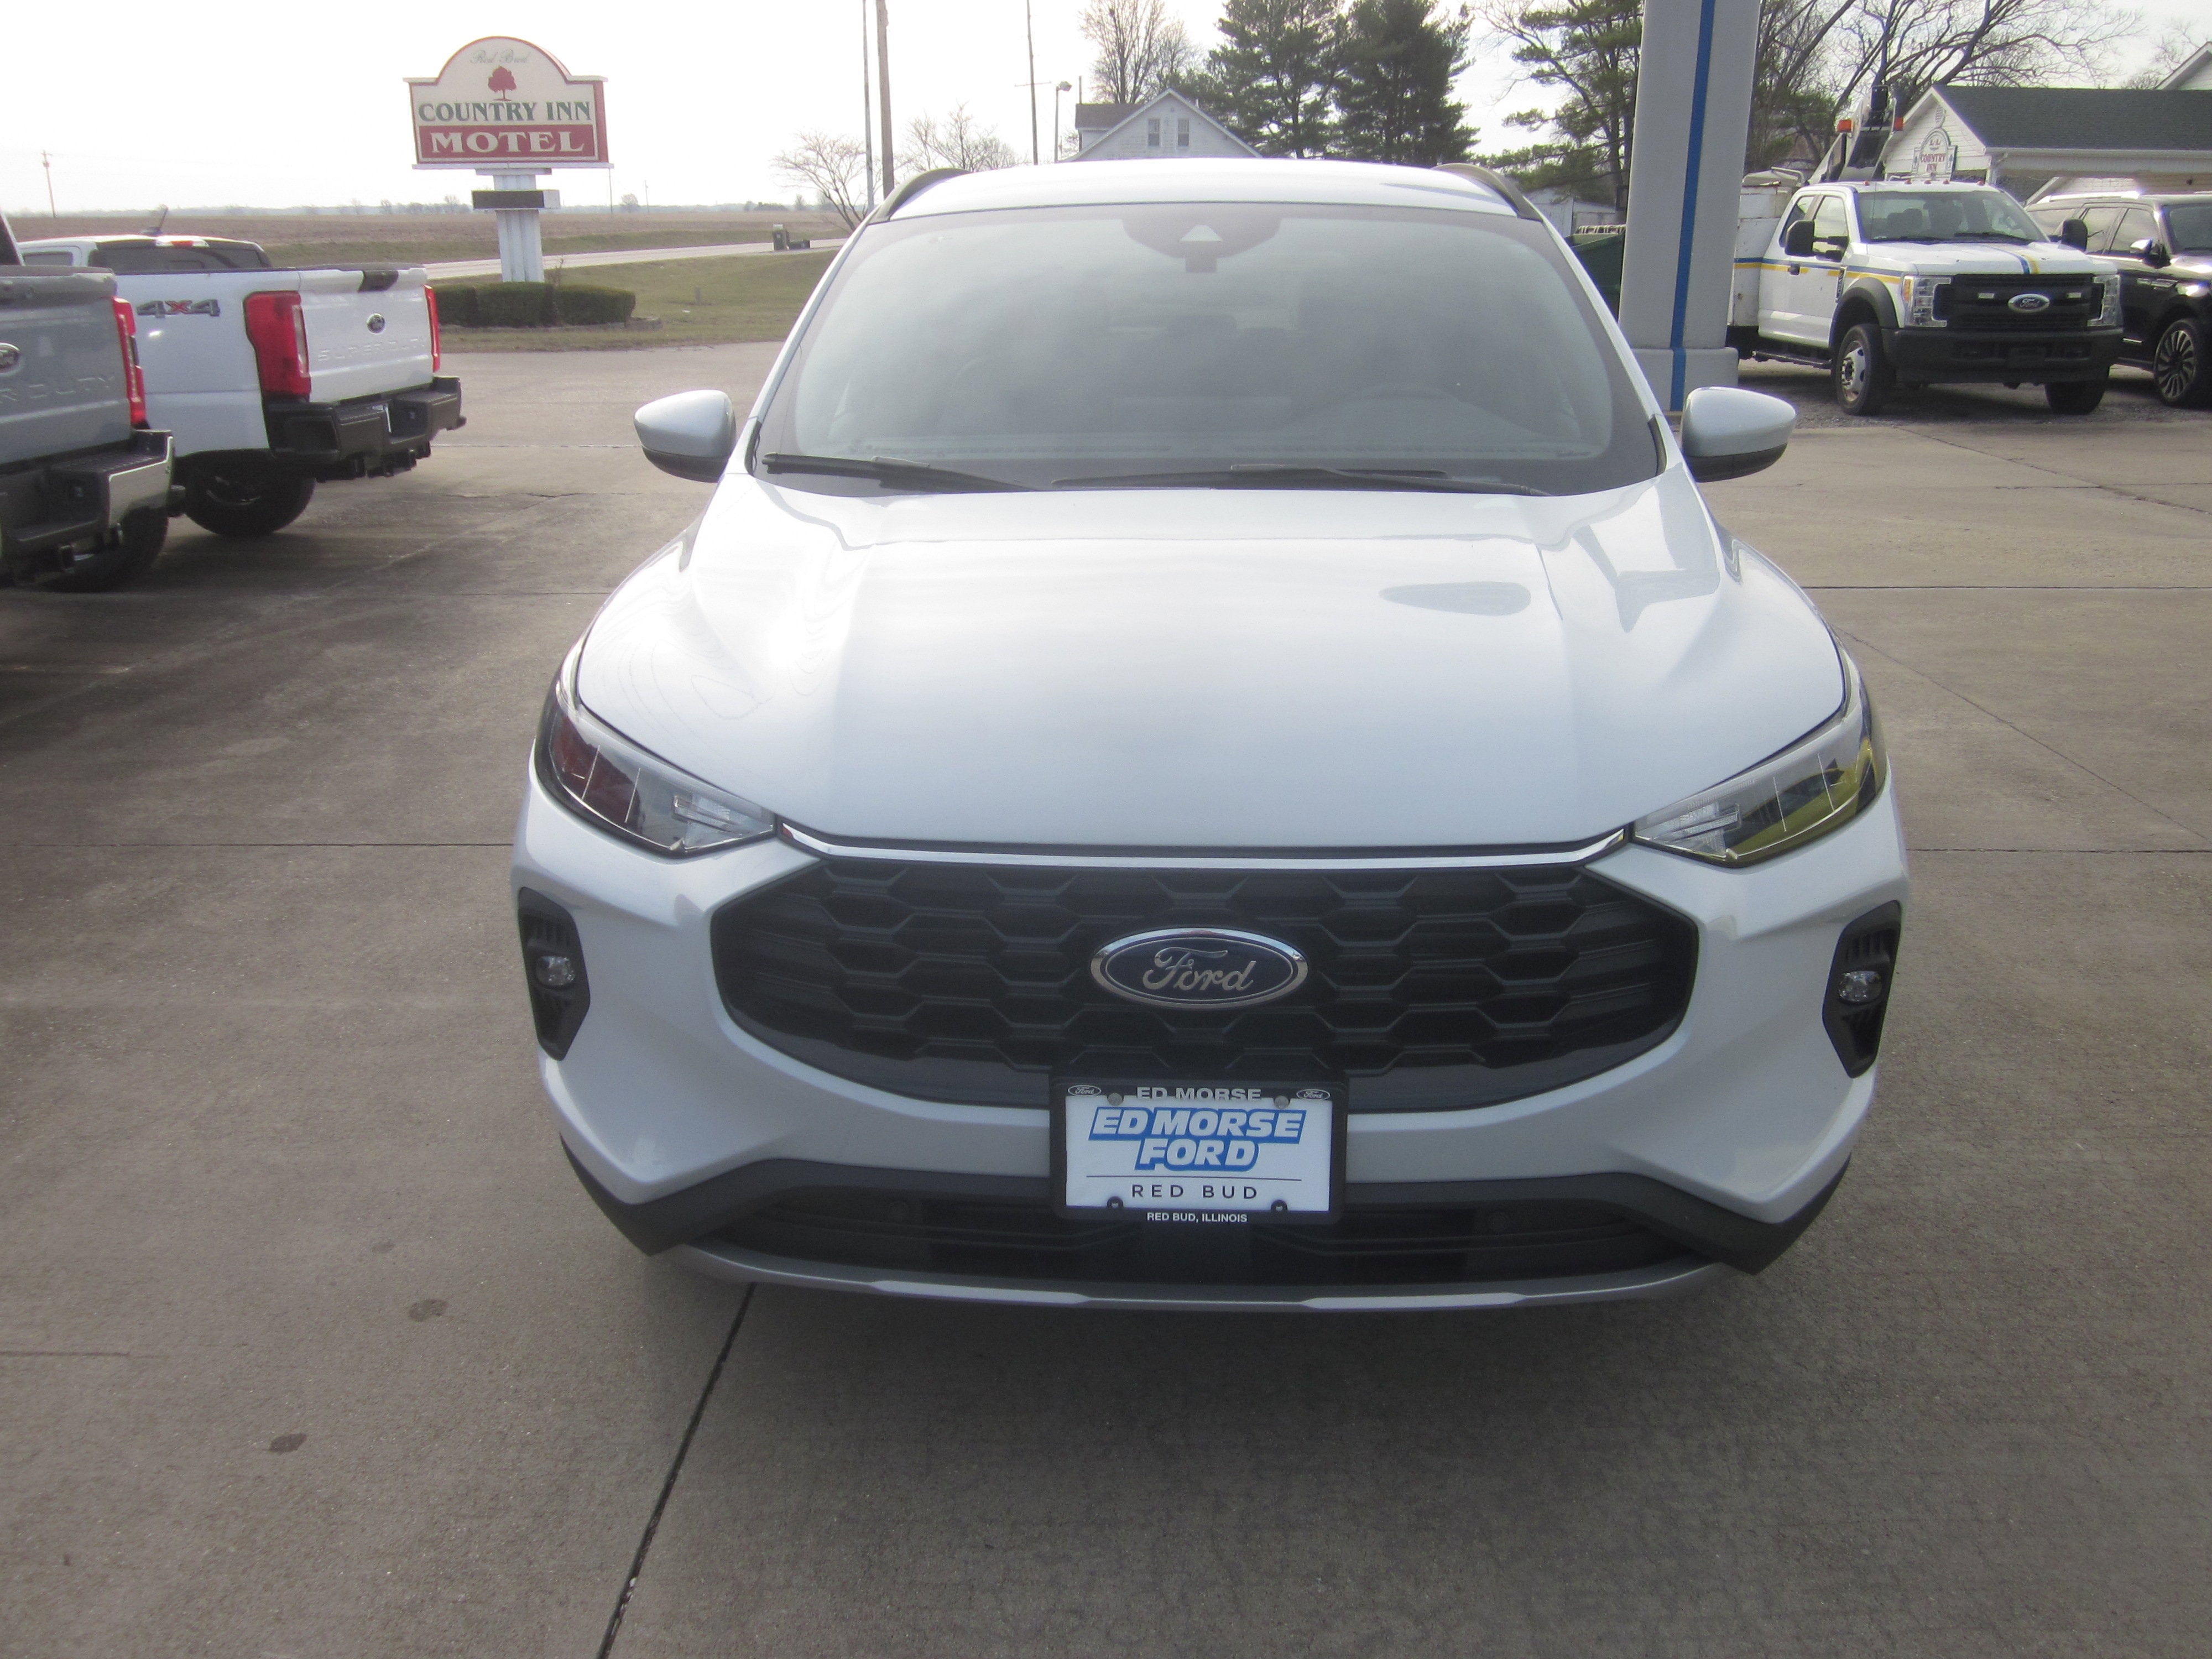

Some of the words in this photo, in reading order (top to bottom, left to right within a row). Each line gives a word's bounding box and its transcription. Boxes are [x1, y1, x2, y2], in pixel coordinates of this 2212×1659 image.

[419, 102, 536, 122] COUNTRY
[546, 102, 591, 121] INN
[431, 132, 585, 153] MOTEL
[1142, 947, 1256, 990] Ford
[1075, 1086, 1094, 1094] Ford
[1137, 1087, 1168, 1099] ED
[1176, 1087, 1261, 1101] MORSE
[1303, 1091, 1323, 1099] Ford
[1093, 1108, 1148, 1135] ED
[1151, 1110, 1303, 1138] MORSE
[1139, 1138, 1255, 1166] FORD
[1131, 1185, 1184, 1198] RED
[1203, 1186, 1257, 1199] BUD
[1147, 1212, 1170, 1221] RED
[1172, 1213, 1199, 1223] BUD,
[1202, 1213, 1248, 1222] ILLINOIS
